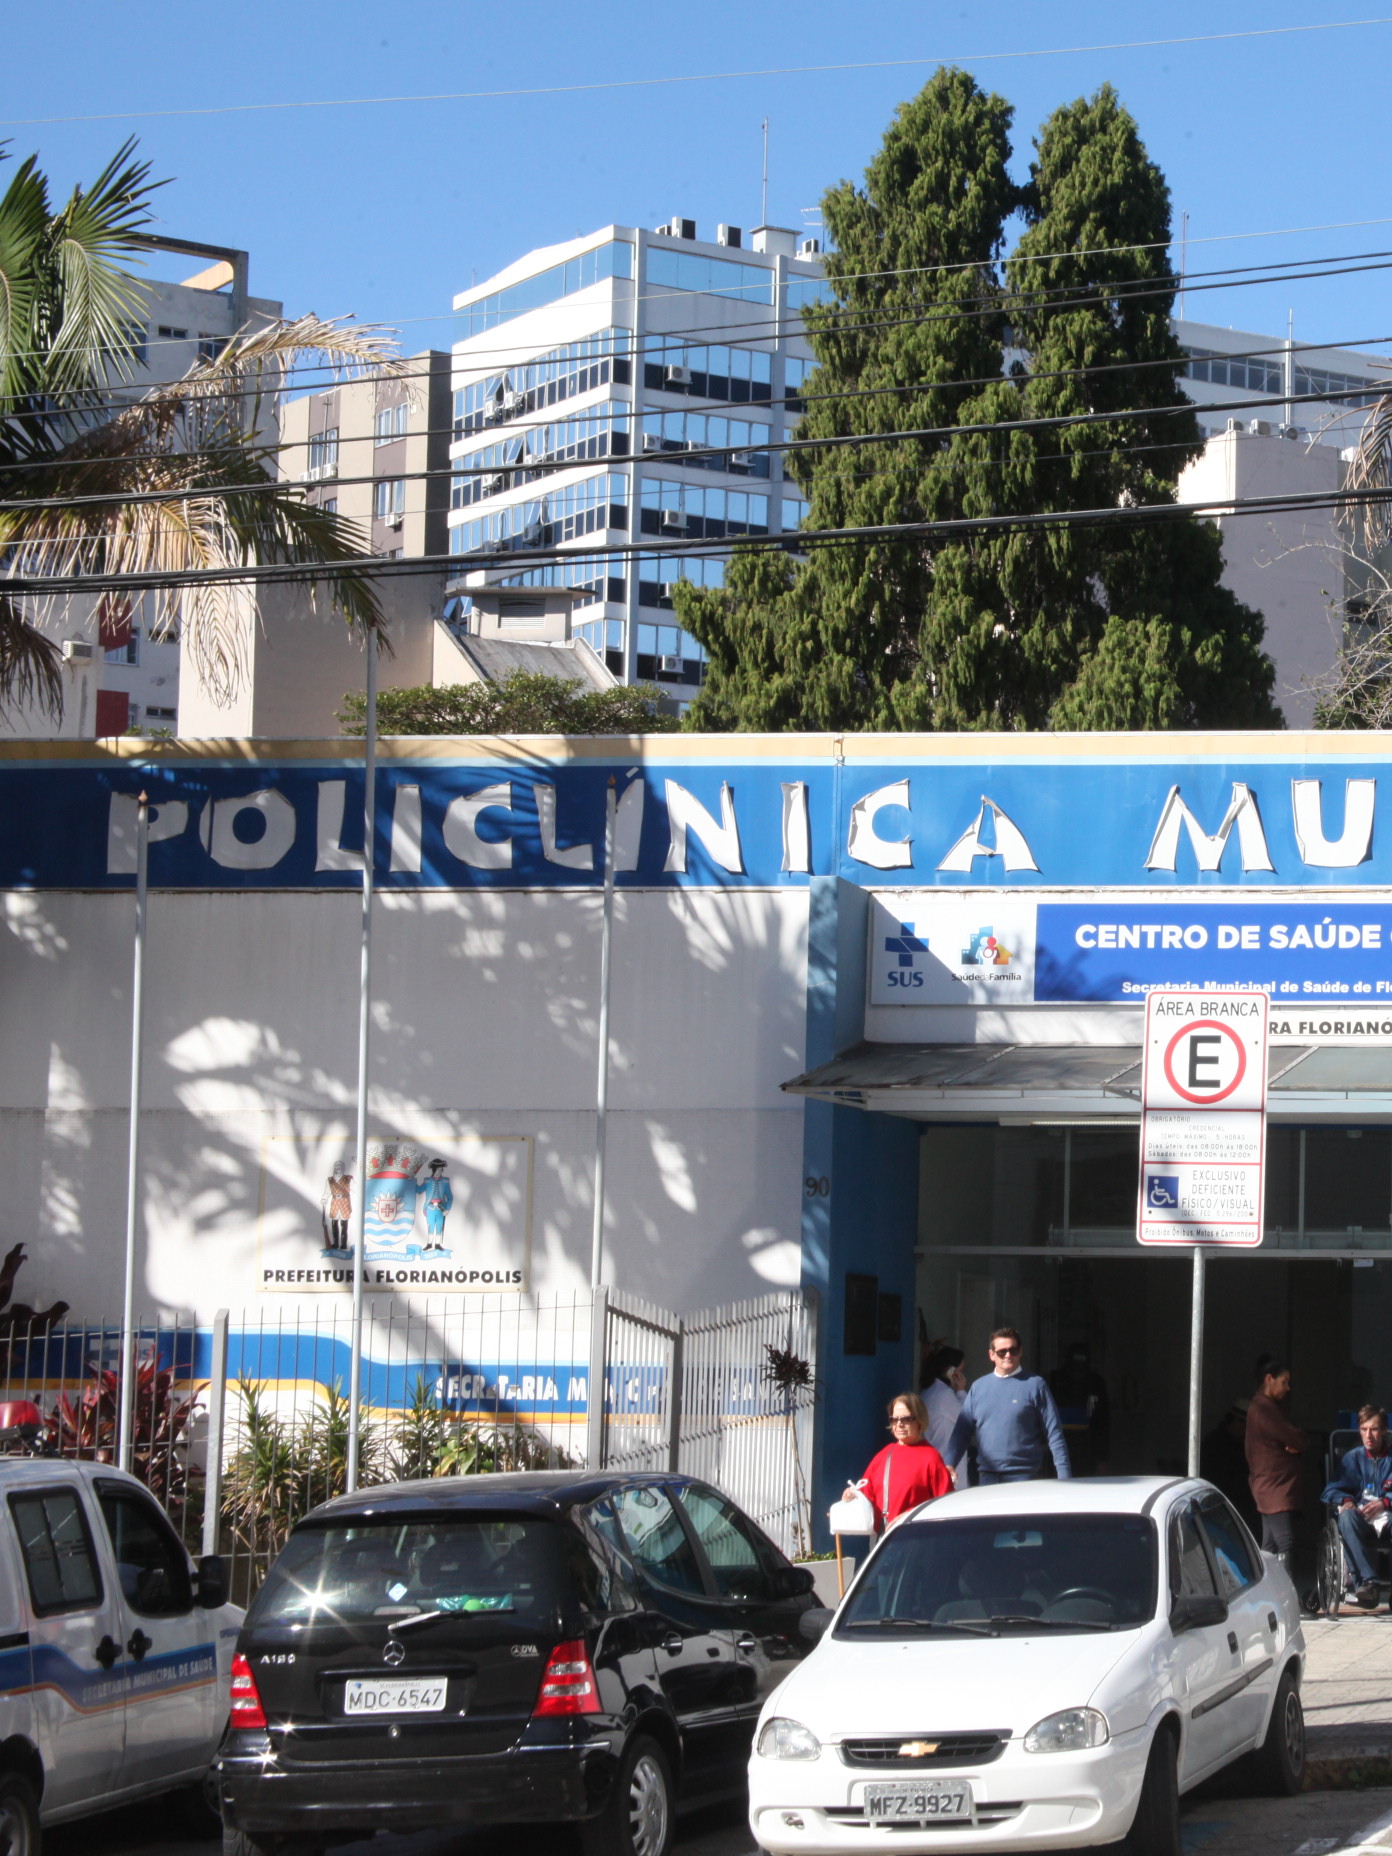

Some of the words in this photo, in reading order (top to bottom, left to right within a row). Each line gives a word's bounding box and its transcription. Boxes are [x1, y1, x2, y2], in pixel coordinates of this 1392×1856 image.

[107, 767, 1042, 876] POLICLÍNICA
[1075, 923, 1208, 949] CENTRO
[1217, 924, 1260, 949] DE
[1269, 917, 1381, 949] SAÚDE
[887, 971, 924, 987] SUS
[1122, 981, 1199, 993] Secretaria
[1204, 981, 1276, 993] Municipal
[1280, 981, 1299, 994] de
[1303, 980, 1349, 994] Saúde
[1353, 981, 1372, 994] de
[1155, 996, 1195, 1016] ÁREA
[1200, 1001, 1260, 1017] BRANCA
[1188, 1035, 1221, 1088] E
[1151, 1114, 1191, 1123] OBRIGATÓRIO
[1192, 1170, 1246, 1181] EXCLUSIVO
[805, 1176, 830, 1198] 90
[1191, 1184, 1246, 1195] DEFICIENTE
[1181, 1195, 1255, 1210] FÍSICO/VISUAL
[1195, 1229, 1214, 1237] Motos
[1220, 1229, 1255, 1238] Caminhões
[363, 1252, 413, 1261] LORIANÓPOLIS
[376, 1265, 522, 1284] FLORIANÓPOLIS
[436, 1374, 559, 1400] SECRTARIA
[521, 1644, 538, 1654] DVA
[133, 1667, 177, 1689] MUNICIPAL
[178, 1663, 189, 1677] DE
[190, 1655, 213, 1675] SAÚDE
